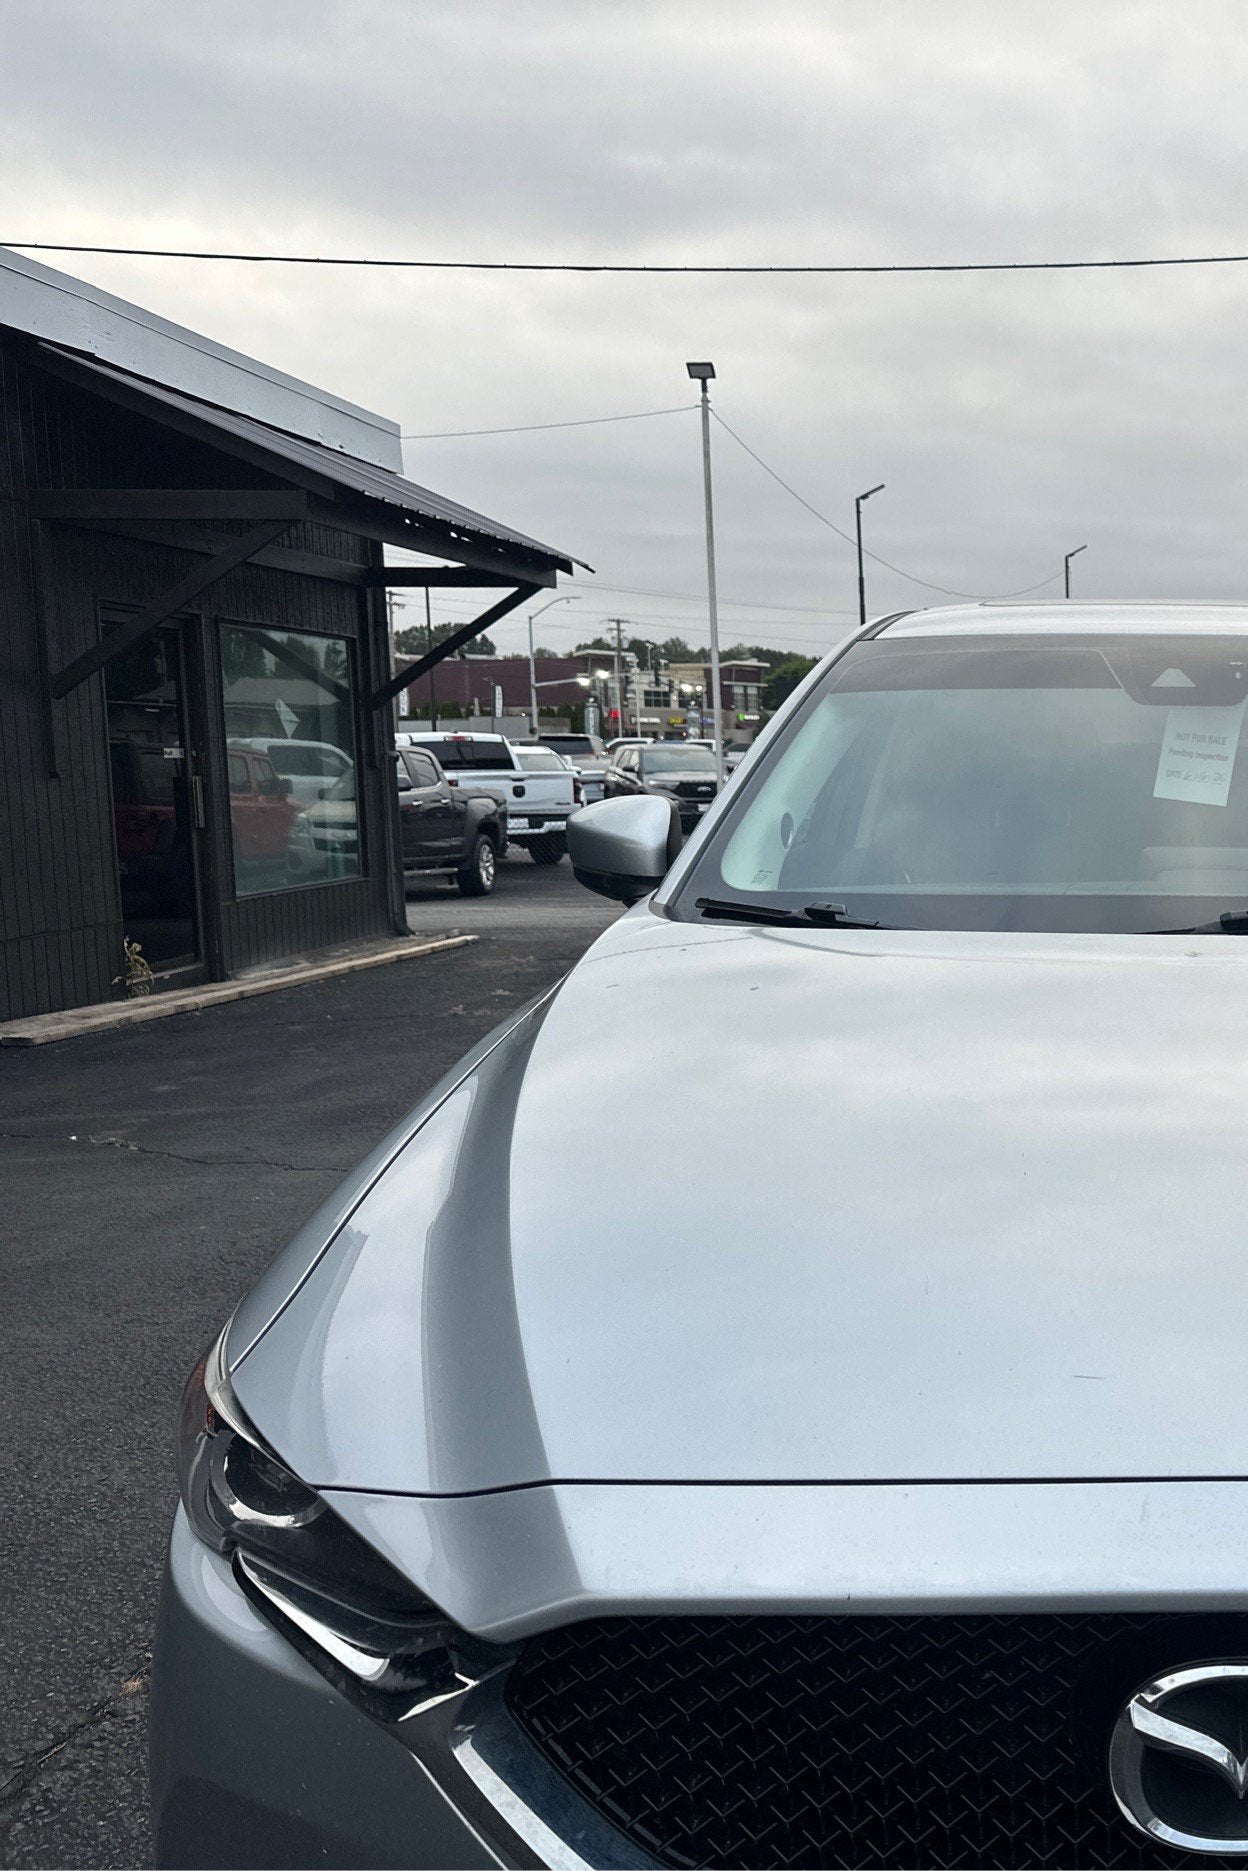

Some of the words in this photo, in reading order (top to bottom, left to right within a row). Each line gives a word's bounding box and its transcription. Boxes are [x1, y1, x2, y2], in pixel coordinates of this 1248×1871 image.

[1175, 732, 1190, 741] NOT
[1191, 734, 1206, 743] FOR
[1208, 735, 1227, 745] SALE
[1169, 748, 1194, 759] Pending
[1195, 751, 1229, 762] Inspection
[1166, 769, 1182, 779] DATE
